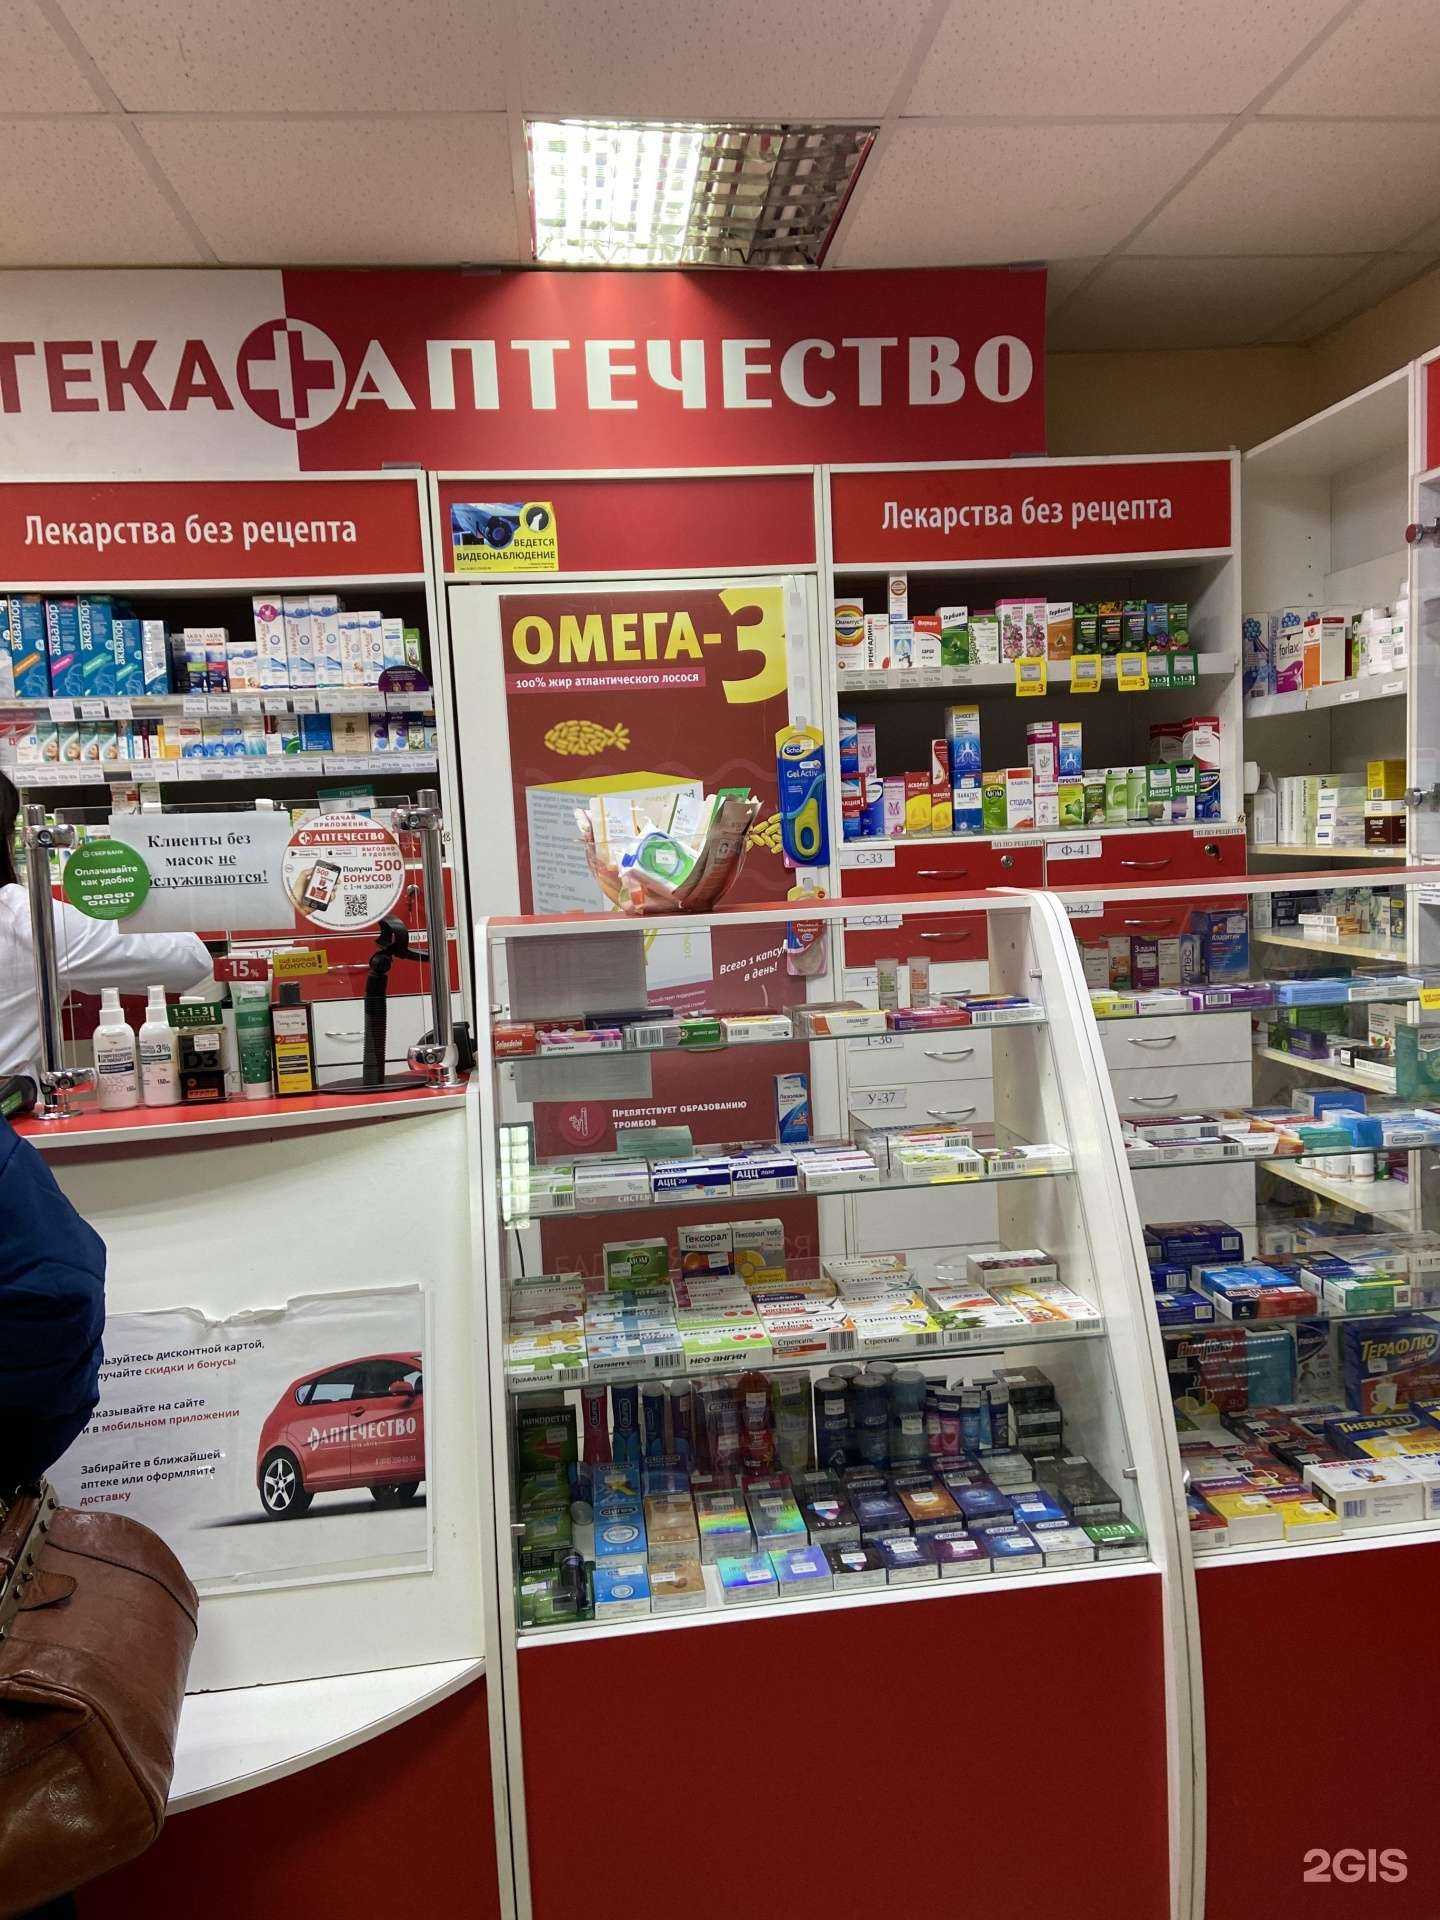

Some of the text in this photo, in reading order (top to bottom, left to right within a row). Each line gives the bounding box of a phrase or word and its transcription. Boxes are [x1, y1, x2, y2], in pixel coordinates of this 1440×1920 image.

[345, 335, 1034, 411] АПТЕЧЕСТВО
[882, 496, 1173, 534] Лекарства без рецепта
[24, 513, 358, 552] Лекарства без рецепта
[513, 538, 555, 548] ВЕДЕТСЯ
[456, 551, 556, 562] ВИДЕОНАБЛЮДЕНИЕ
[516, 672, 699, 689] 100% жир атлантического лосося
[147, 832, 251, 848] Клиенты без
[313, 831, 385, 842] АПТЕЧЕСТВО
[166, 853, 237, 867] масок не
[374, 859, 402, 871] 500
[74, 866, 139, 877] Оплачивайте
[149, 869, 268, 889] служиваются!
[343, 873, 392, 883] БОНУСОВ
[80, 875, 135, 887] как удобно
[719, 960, 746, 975] Всего
[756, 943, 788, 961] капсу
[744, 962, 778, 982] в день!
[685, 1233, 728, 1244] Гексорал
[101, 1338, 265, 1366] ьзуйтесь дисконтной картой,
[98, 1367, 142, 1382] лучайте
[144, 1363, 184, 1376] скидки
[197, 1358, 236, 1370] бонусы
[90, 1398, 205, 1419] аказывайте на сайте
[102, 1417, 166, 1433] мобильном
[169, 1409, 240, 1426] приложении
[320, 1417, 417, 1445] АПТЕЧЕСТВО
[81, 1460, 141, 1475] Забирайте
[153, 1448, 221, 1466] ближайшей
[81, 1477, 119, 1490] аптеке
[121, 1473, 144, 1485] или
[80, 1491, 131, 1507] доставку
